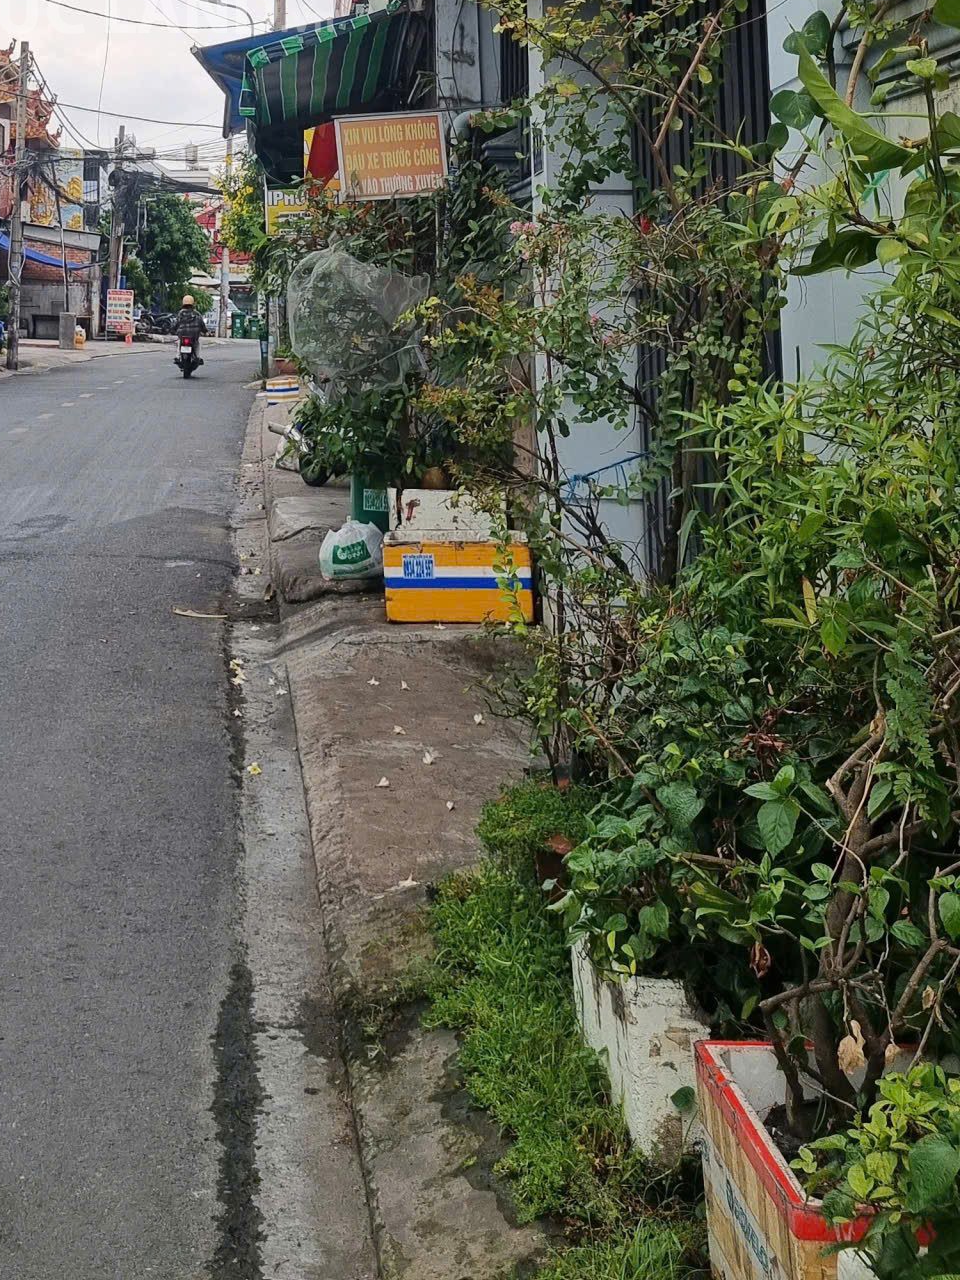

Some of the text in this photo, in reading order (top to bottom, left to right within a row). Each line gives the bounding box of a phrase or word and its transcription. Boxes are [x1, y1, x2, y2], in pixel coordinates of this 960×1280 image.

[344, 120, 437, 145] XIN VUI LÒNG KHÔNG
[366, 151, 380, 169] XE
[381, 146, 411, 168] TRƯỚC
[413, 142, 440, 166] CỔNG
[361, 175, 378, 194] VÀO
[380, 172, 413, 193] THƯỜNG
